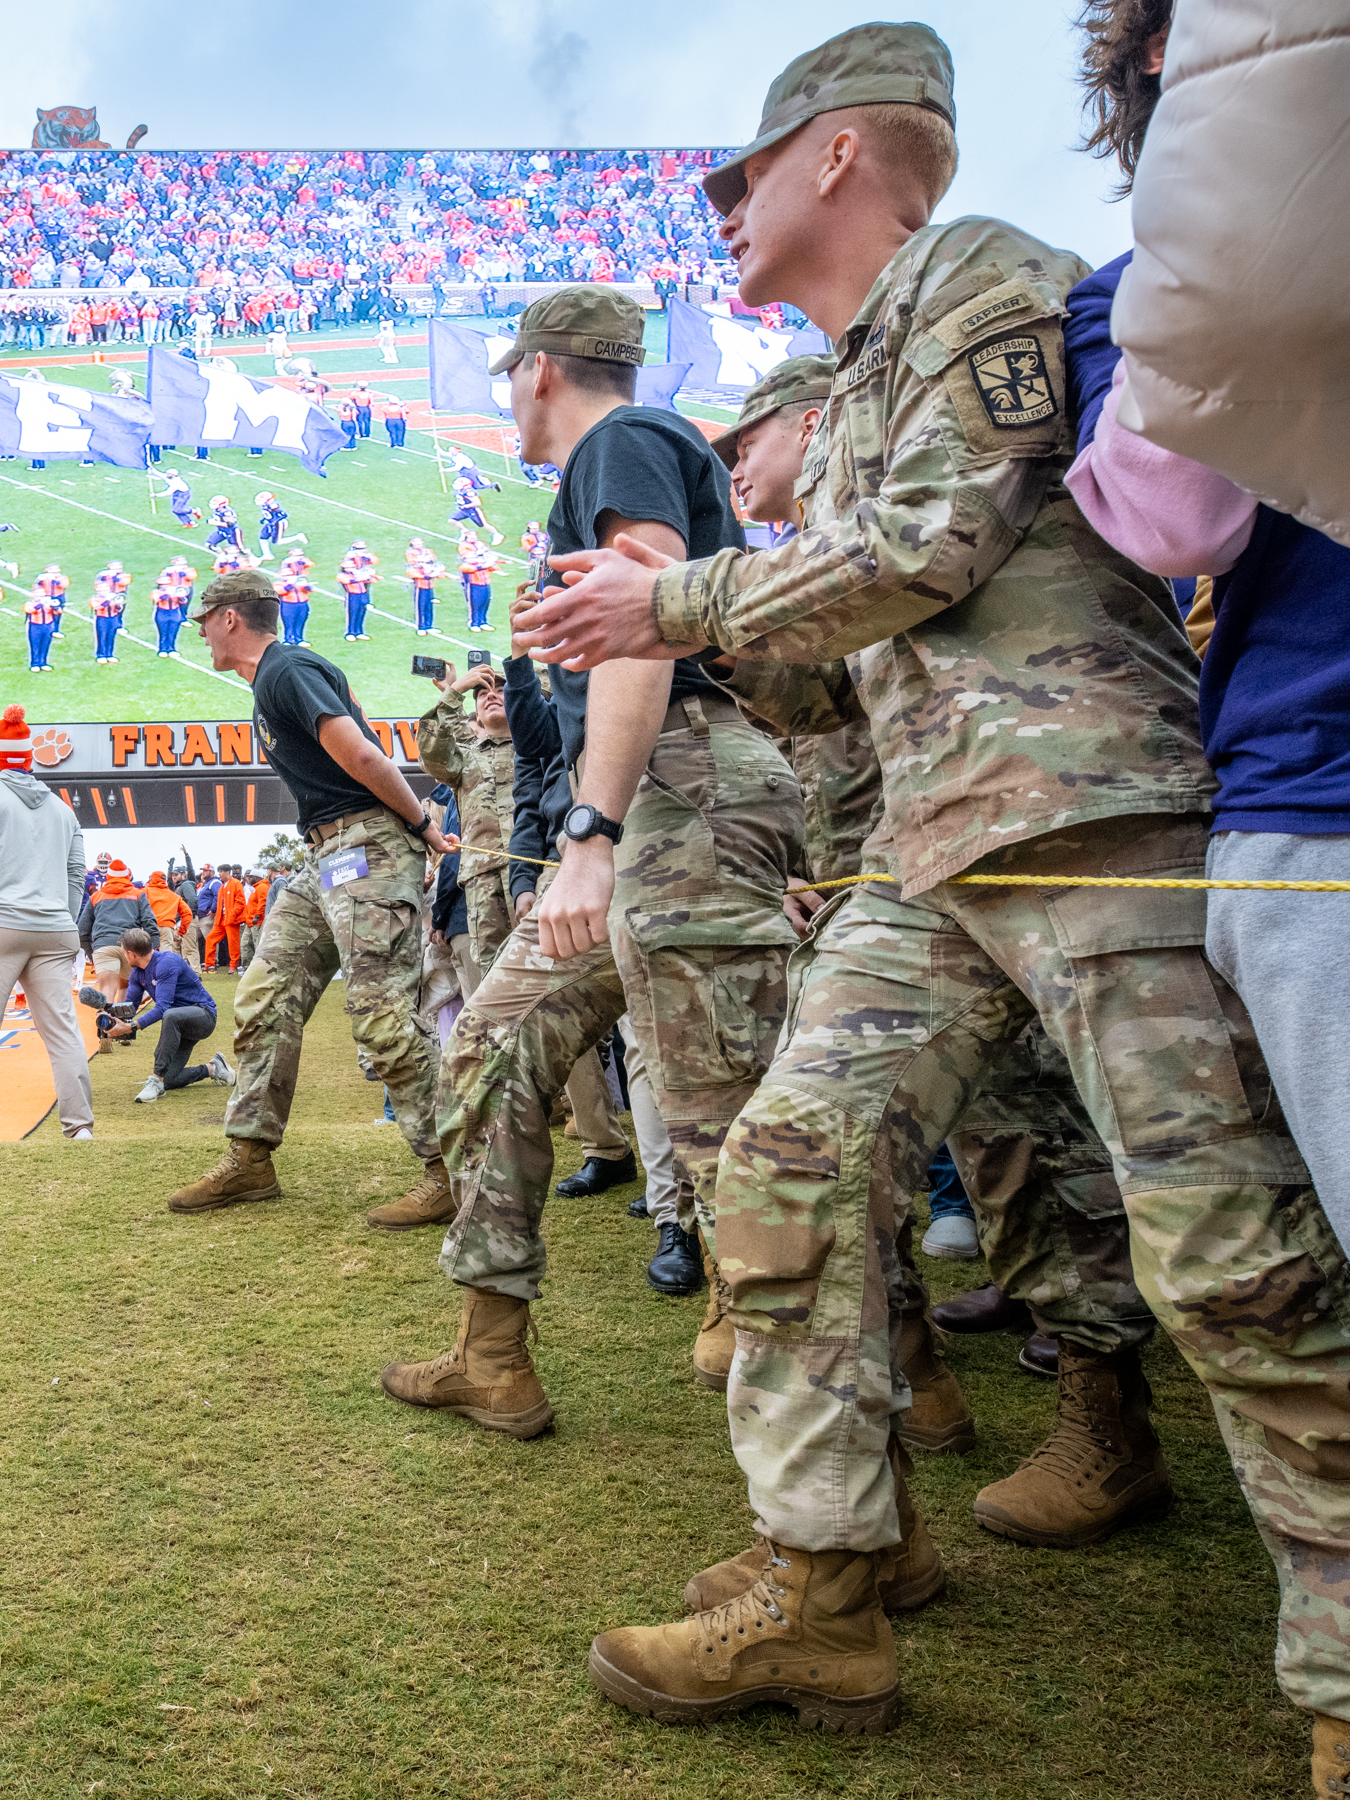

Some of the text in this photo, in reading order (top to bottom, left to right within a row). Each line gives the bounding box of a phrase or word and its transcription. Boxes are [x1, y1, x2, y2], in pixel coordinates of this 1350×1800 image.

[967, 297, 1021, 328] SAPPER
[595, 340, 641, 362] CAMPBELL
[974, 340, 1034, 364] LEADERSHIP
[997, 402, 1053, 423] EXCELLENCE
[110, 723, 268, 768] FRAN
[329, 853, 355, 866] CLEMSON
